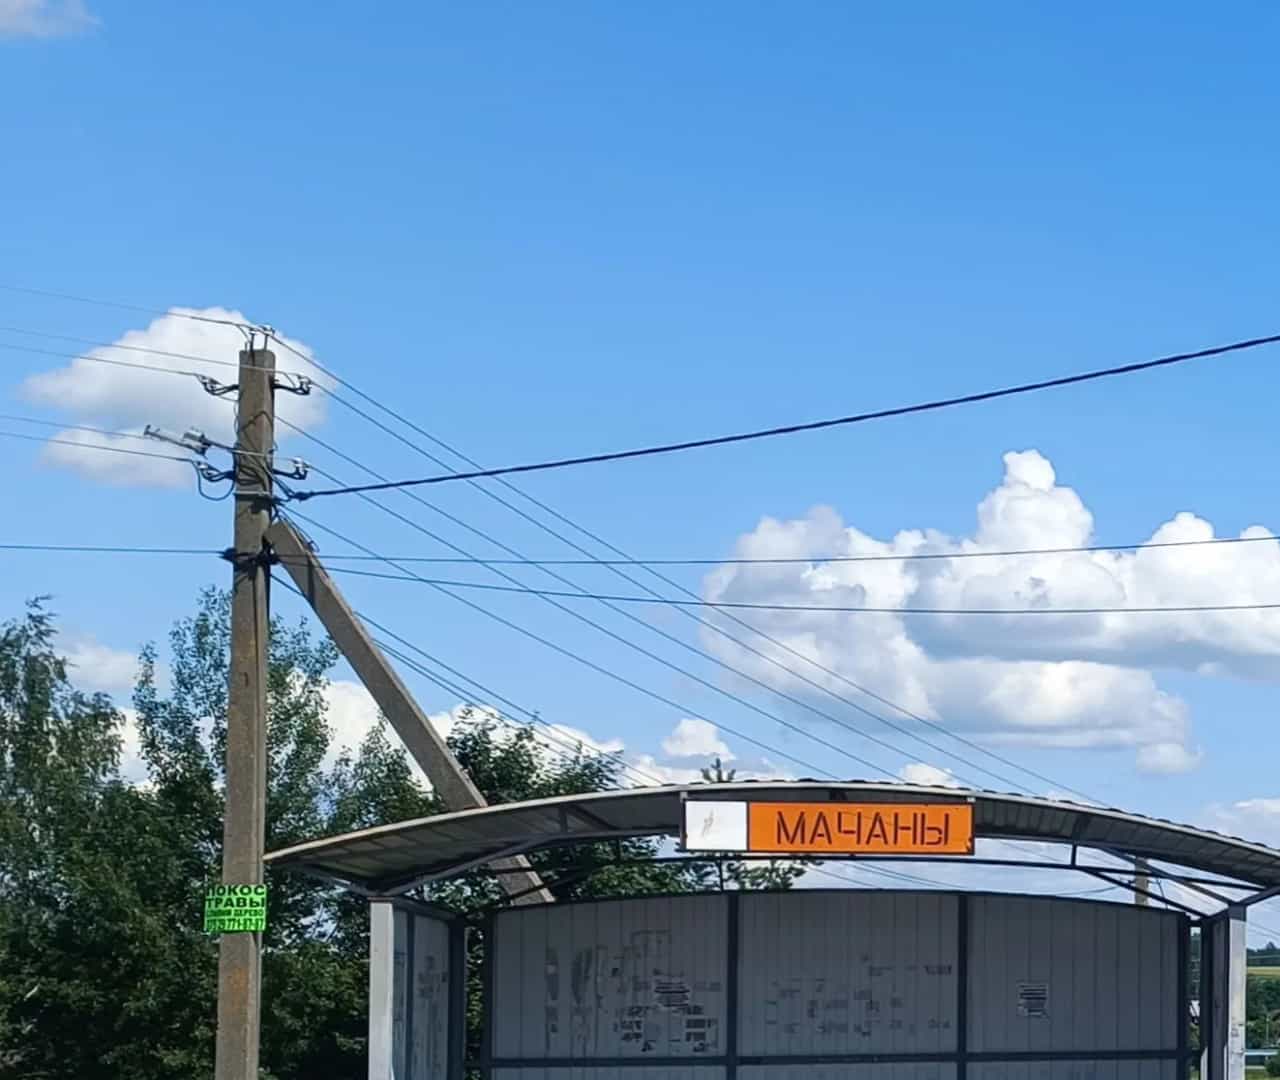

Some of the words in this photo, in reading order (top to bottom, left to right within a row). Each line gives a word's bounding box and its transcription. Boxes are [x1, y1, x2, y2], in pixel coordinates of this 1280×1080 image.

[777, 811, 950, 846] МАЧАНЫ
[206, 885, 265, 896] ПОКОС
[205, 898, 265, 908] ТРАВЫ
